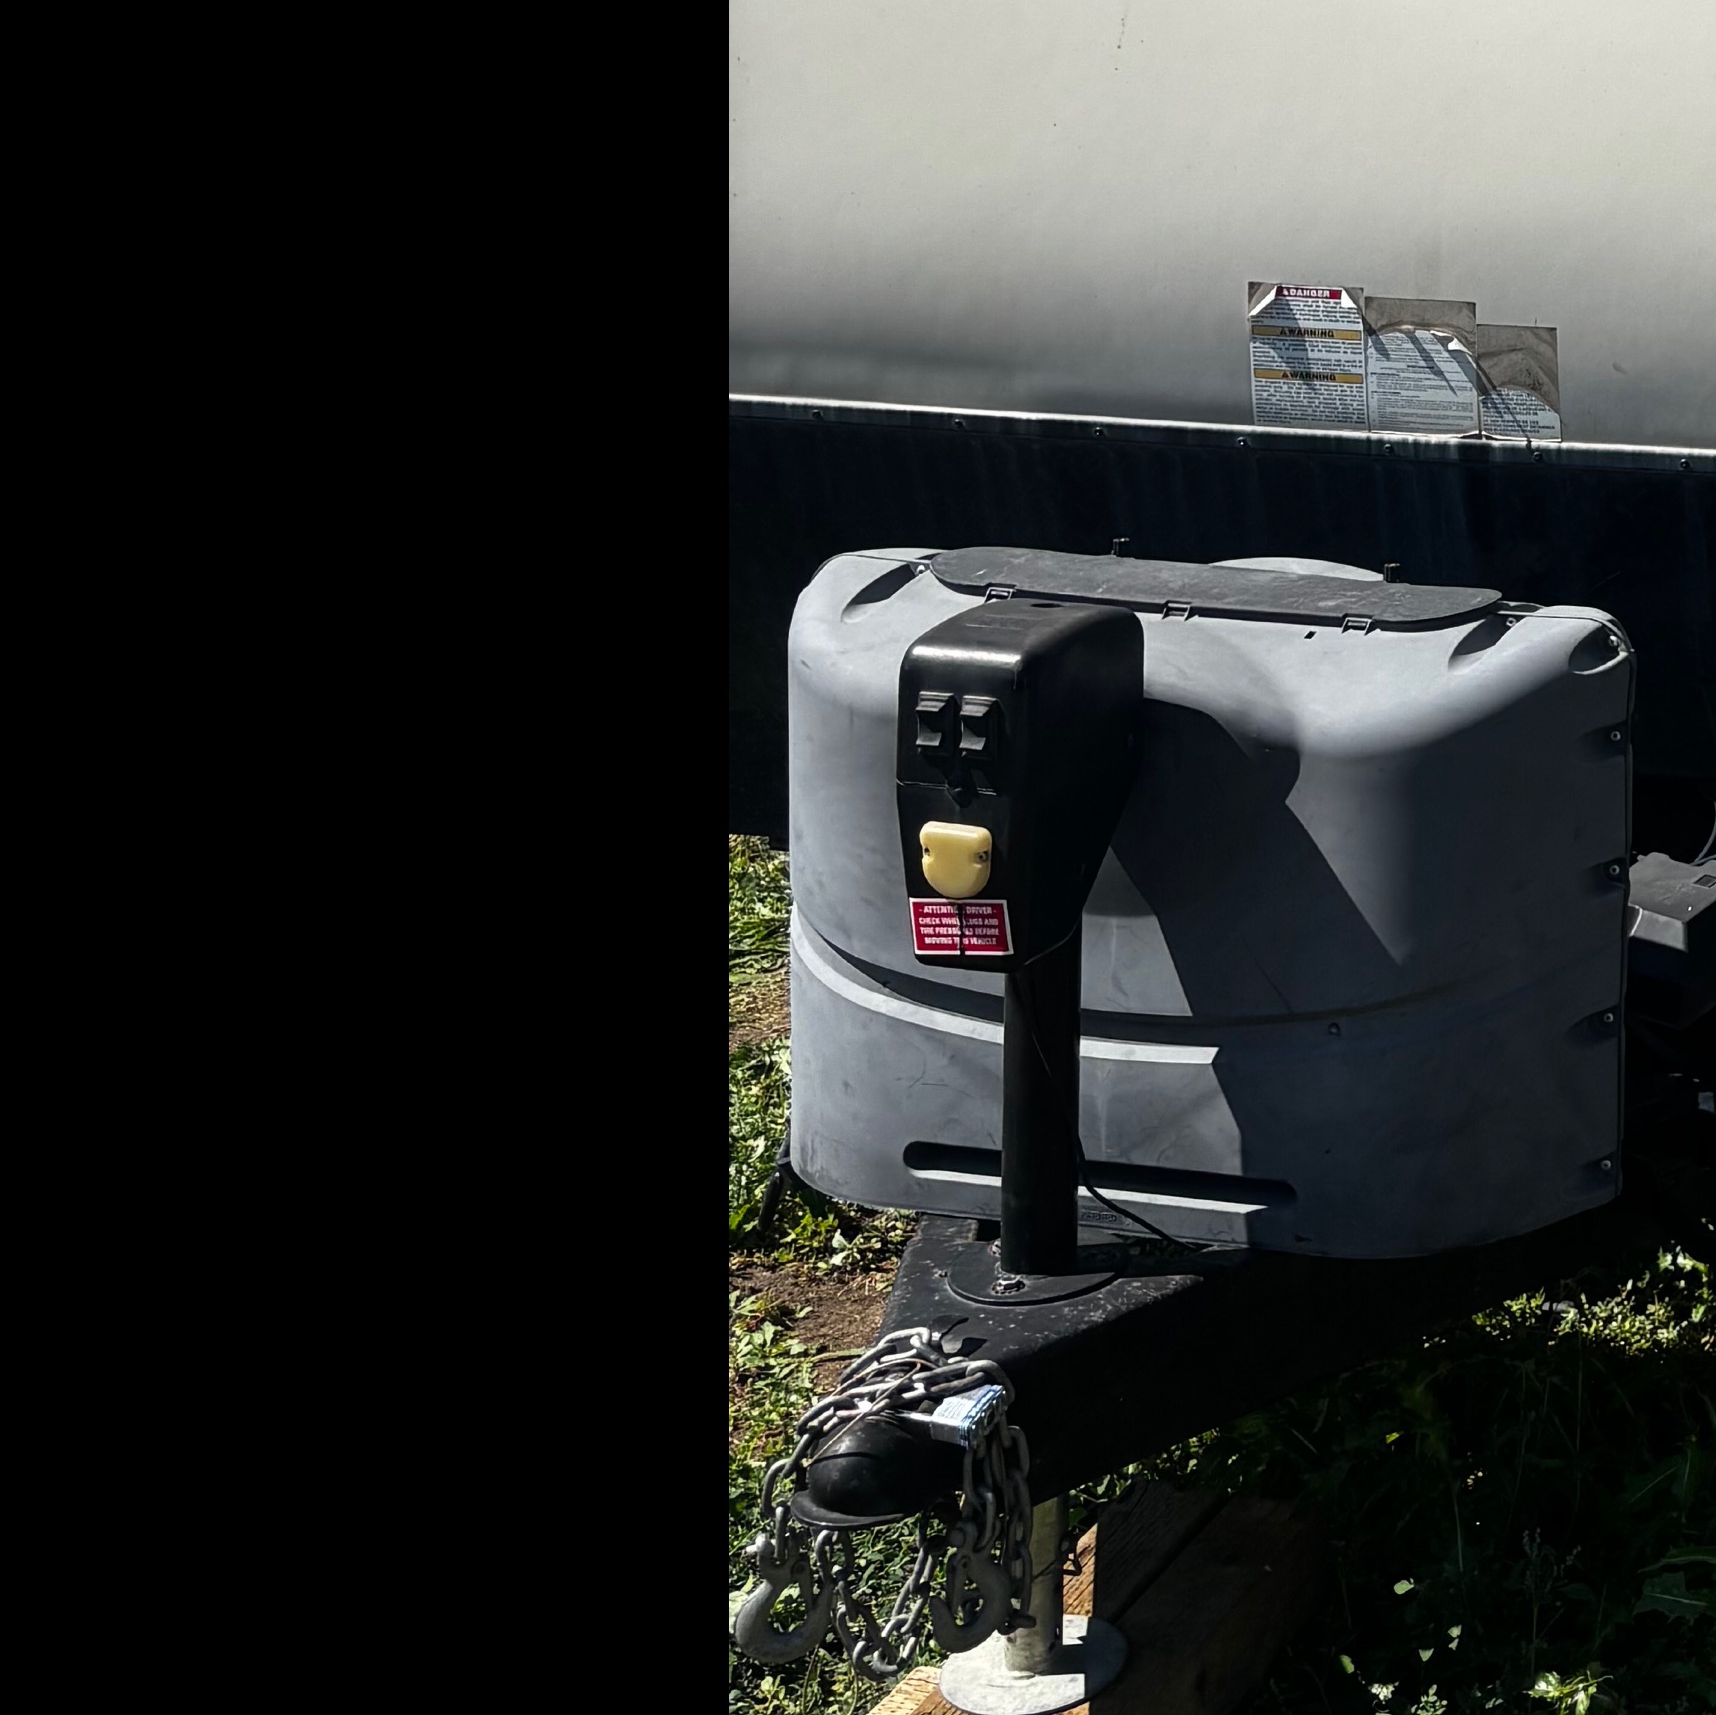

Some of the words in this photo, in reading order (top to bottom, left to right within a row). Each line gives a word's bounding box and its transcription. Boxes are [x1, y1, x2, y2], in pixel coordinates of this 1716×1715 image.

[1289, 287, 1331, 298] DANGER
[1286, 326, 1335, 338] WARNING
[1289, 371, 1337, 381] WARNING
[966, 906, 992, 915] DRIVER
